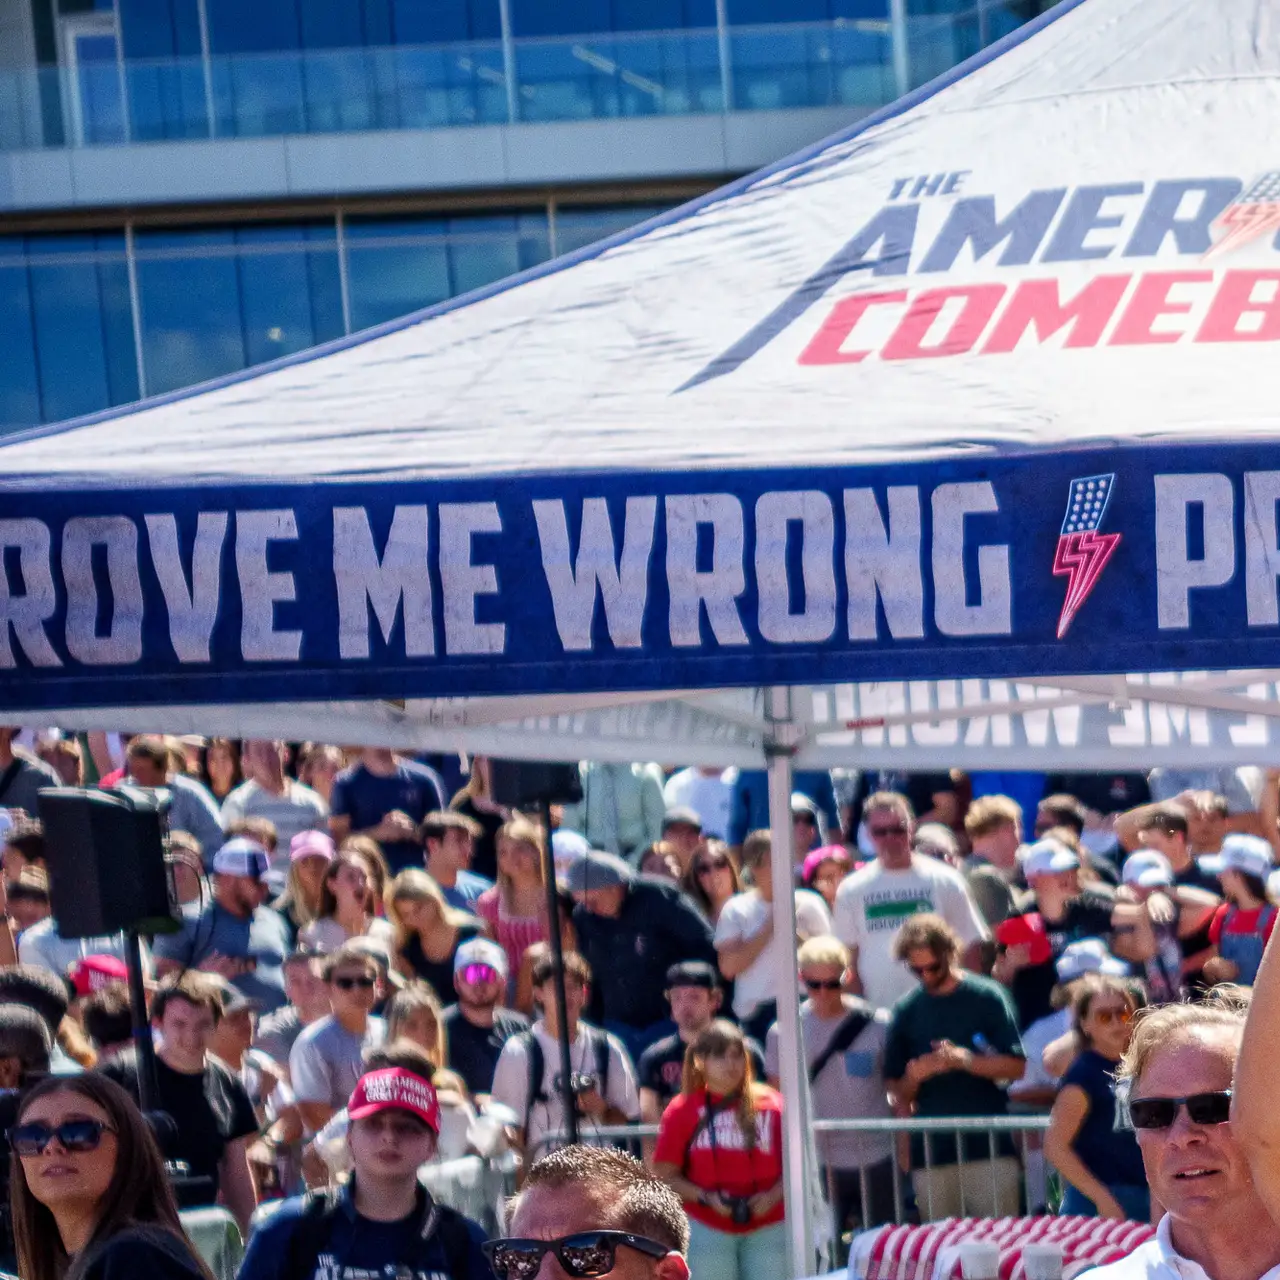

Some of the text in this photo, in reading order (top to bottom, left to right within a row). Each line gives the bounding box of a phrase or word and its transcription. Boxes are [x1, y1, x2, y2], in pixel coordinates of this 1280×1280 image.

[886, 169, 972, 200] THE
[331, 500, 507, 659] ME
[532, 480, 1012, 653] WRONG
